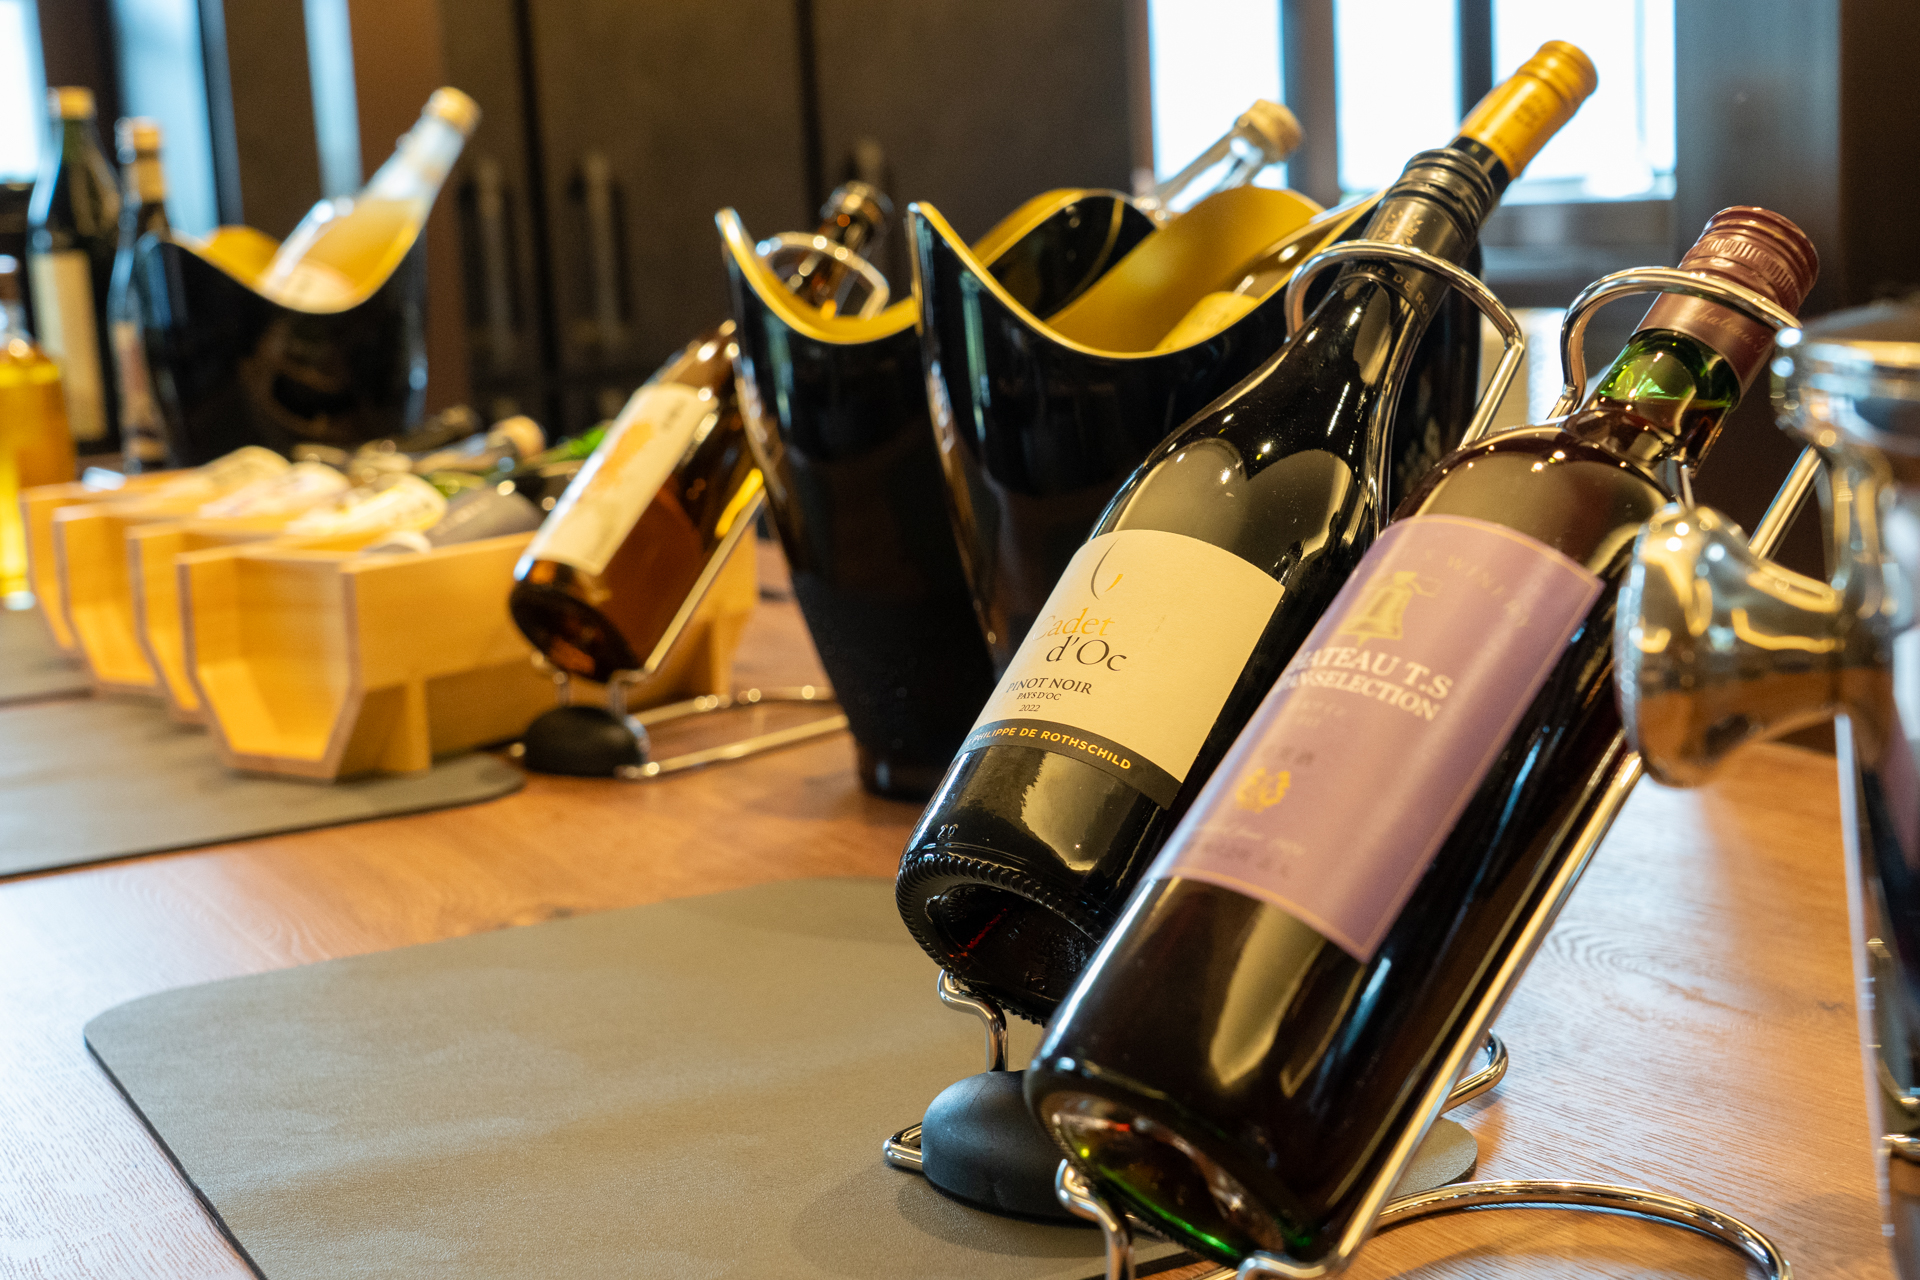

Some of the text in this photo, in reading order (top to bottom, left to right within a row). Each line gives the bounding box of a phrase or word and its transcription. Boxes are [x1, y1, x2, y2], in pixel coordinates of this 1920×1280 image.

[1032, 607, 1116, 641] Cadet
[1046, 635, 1127, 671] d'Oc
[1006, 677, 1093, 695] PINOT NOIR
[1018, 704, 1041, 713] 2022
[971, 727, 1017, 744] PHILIPPE
[1019, 727, 1038, 738] DE
[1040, 730, 1131, 770] ROTHSCHILD
